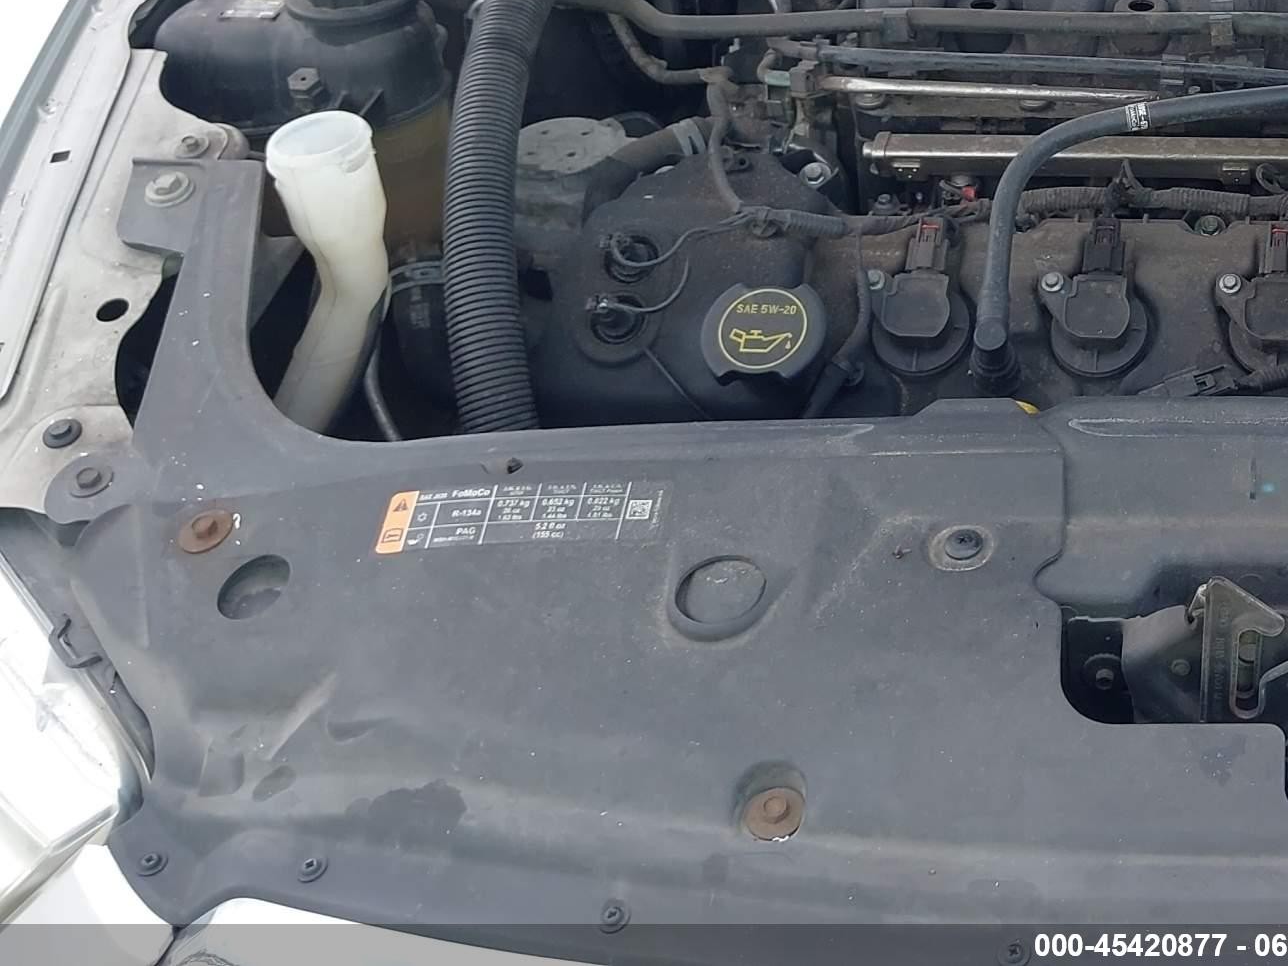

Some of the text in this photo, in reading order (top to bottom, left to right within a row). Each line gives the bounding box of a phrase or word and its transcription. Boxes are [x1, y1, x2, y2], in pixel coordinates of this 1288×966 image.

[736, 304, 798, 315] SAE 5W-20
[452, 488, 491, 498] FoMoCo
[519, 499, 531, 509] kg
[563, 498, 575, 508] kg
[609, 497, 621, 507] kg
[451, 509, 482, 518] R-134a
[456, 526, 476, 536] PAG
